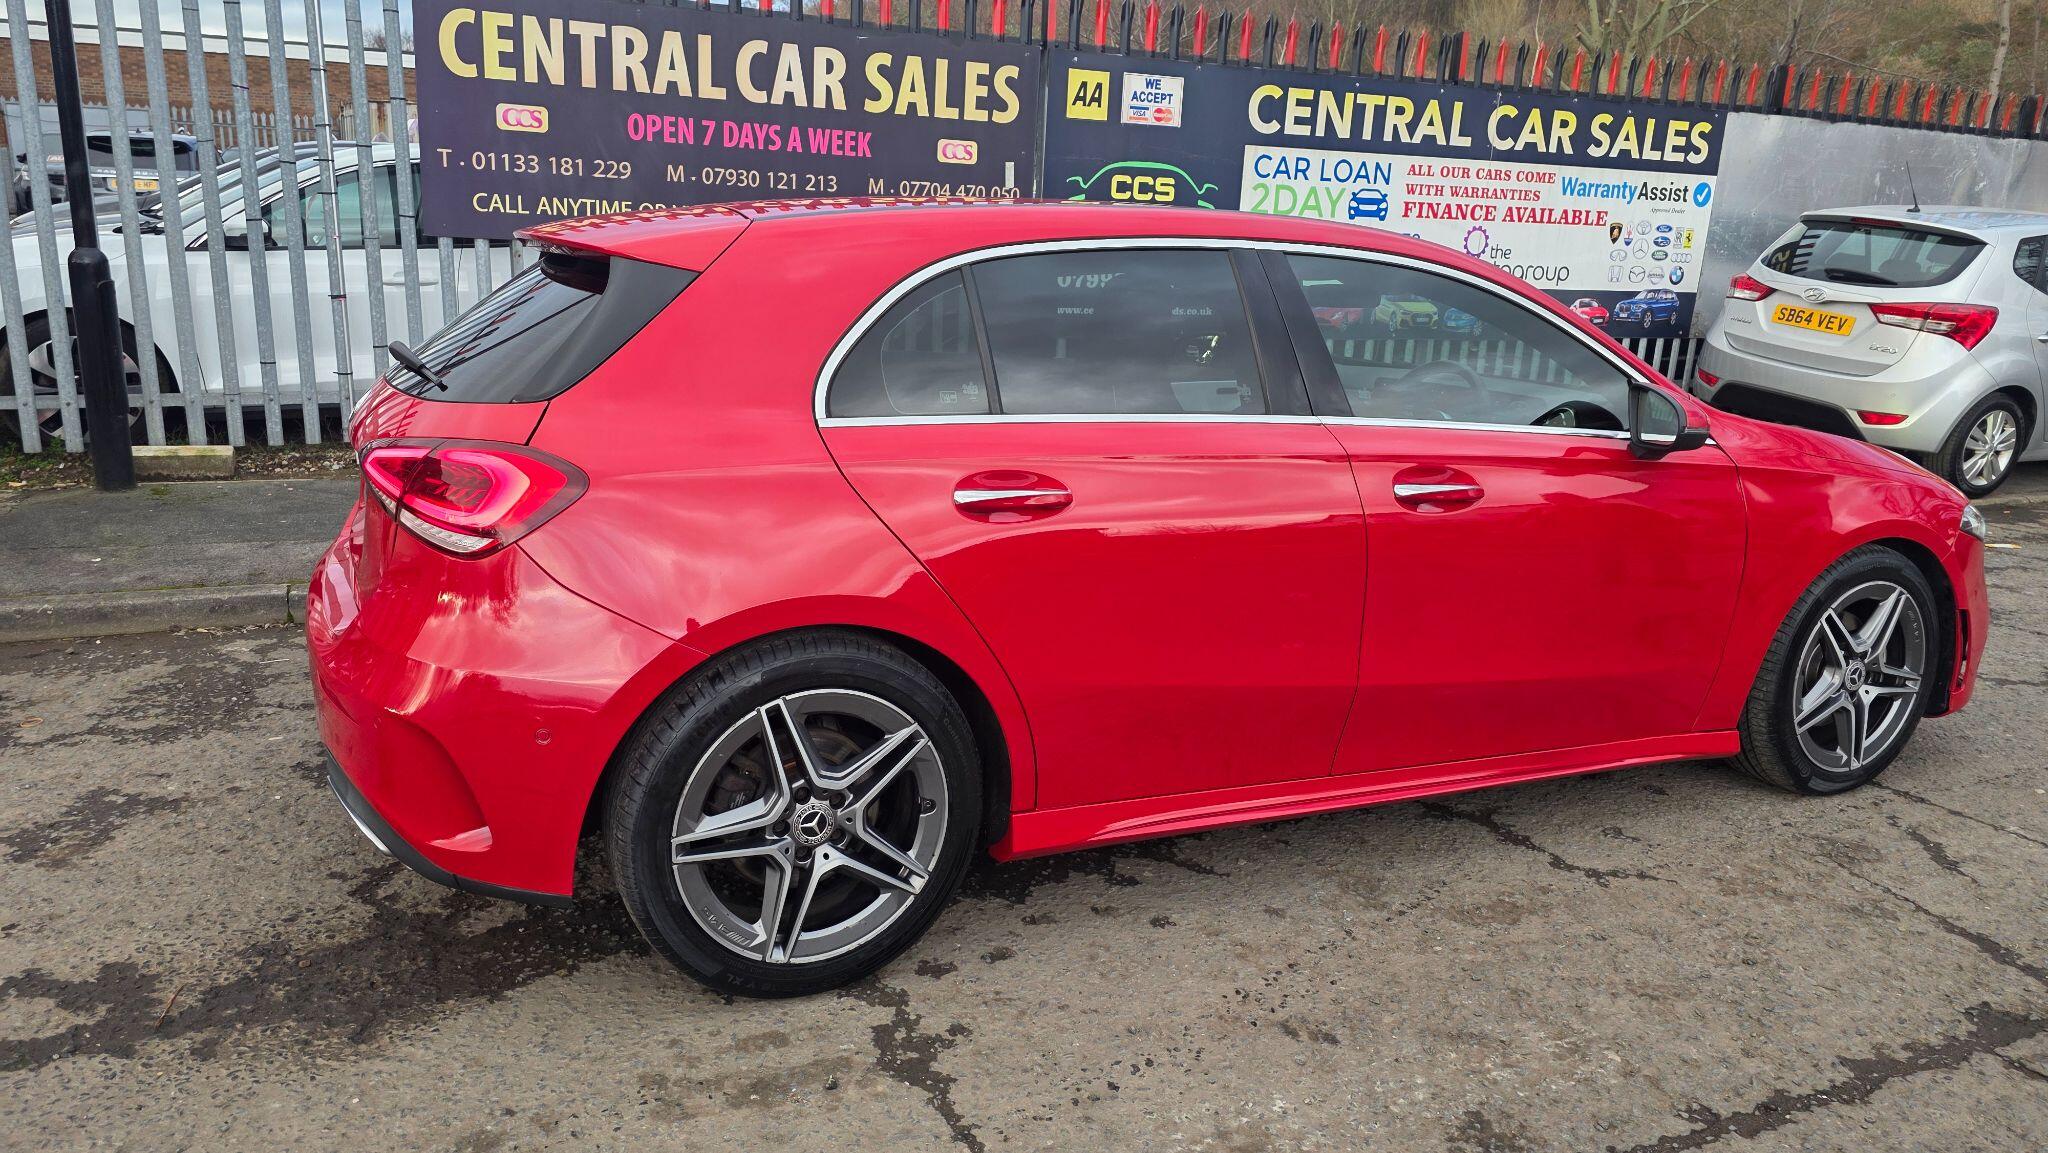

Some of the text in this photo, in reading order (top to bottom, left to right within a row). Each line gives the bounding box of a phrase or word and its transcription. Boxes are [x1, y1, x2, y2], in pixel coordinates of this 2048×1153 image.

[438, 8, 1020, 124] CENTRAL CAR SALES
[1071, 80, 1104, 108] AA
[1145, 77, 1162, 91] WE
[1130, 91, 1174, 105] ACCEPT
[501, 107, 544, 129] CCS
[1248, 84, 1713, 165] CENTRAL CAR SALES
[627, 113, 873, 158] OPEN 7 DAYS A WEEK
[941, 142, 974, 161] CCS
[471, 151, 540, 174] 01133
[549, 156, 584, 177] 181
[592, 159, 633, 180] 229
[1253, 153, 1392, 186] CAR LOAN
[1406, 163, 1557, 184] ALL OUR CARS COME
[702, 167, 760, 188] 07930
[767, 171, 797, 190] 121
[805, 174, 838, 193] 213
[899, 180, 951, 197] 07704
[955, 184, 986, 198] 470
[1110, 174, 1176, 202] CCS
[1405, 183, 1541, 202] WITH WARRANTIES
[1561, 176, 1688, 205] WarrantyAssist
[472, 192, 530, 215] CALL
[536, 196, 633, 217] ANYTIME
[1249, 182, 1347, 219] 2DAY
[1402, 201, 1609, 227] FINANCE AVAILABLE
[1489, 243, 1512, 260] the
[1777, 307, 1849, 332] SB64 VEV
